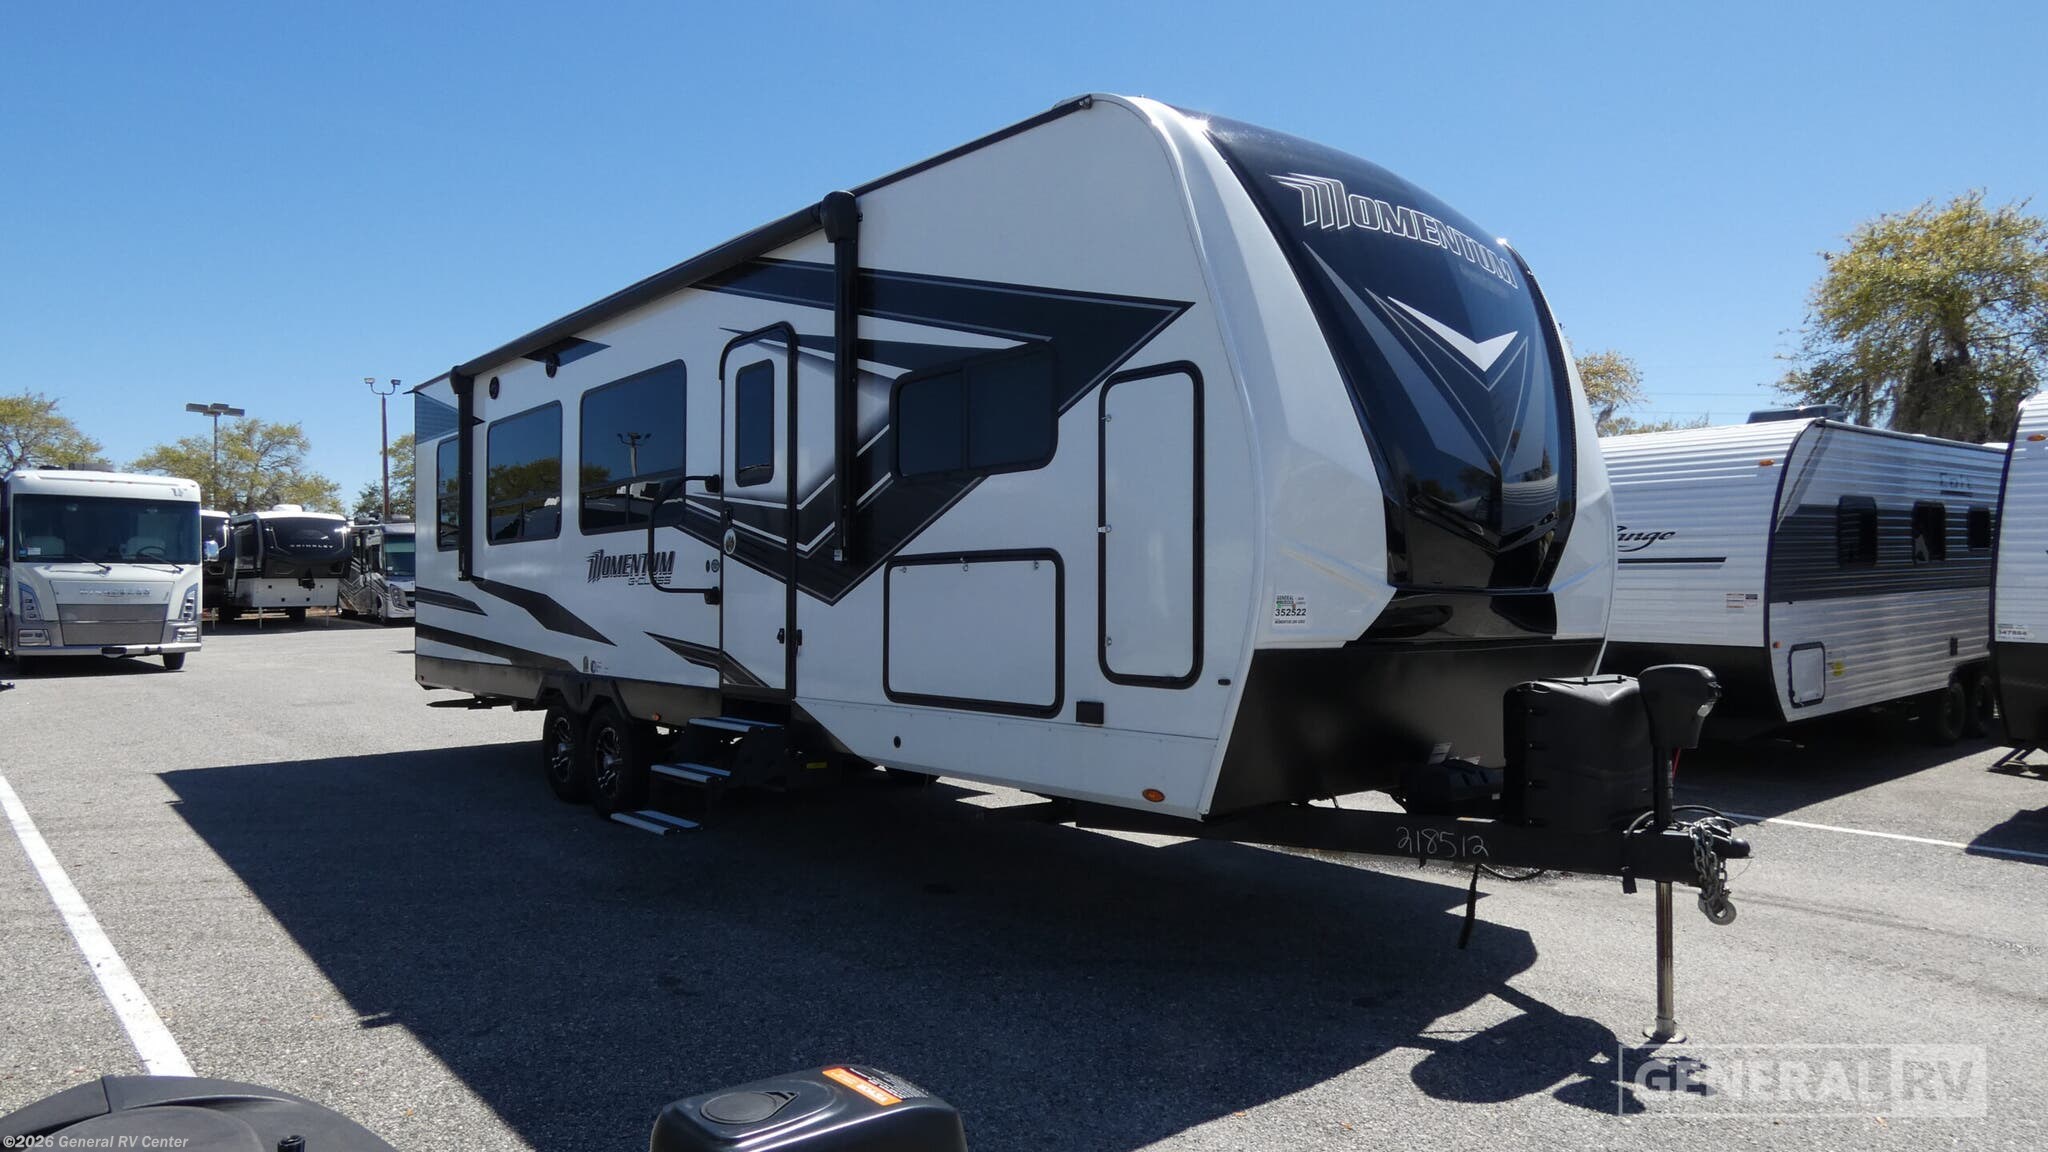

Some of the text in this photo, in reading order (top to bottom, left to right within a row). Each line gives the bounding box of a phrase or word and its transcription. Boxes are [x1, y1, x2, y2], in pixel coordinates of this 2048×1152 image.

[1266, 172, 1519, 289] MOMENTUM
[584, 548, 676, 583] MOMENTUM
[1275, 608, 1307, 617] 352522
[1395, 825, 1490, 858] 218512
